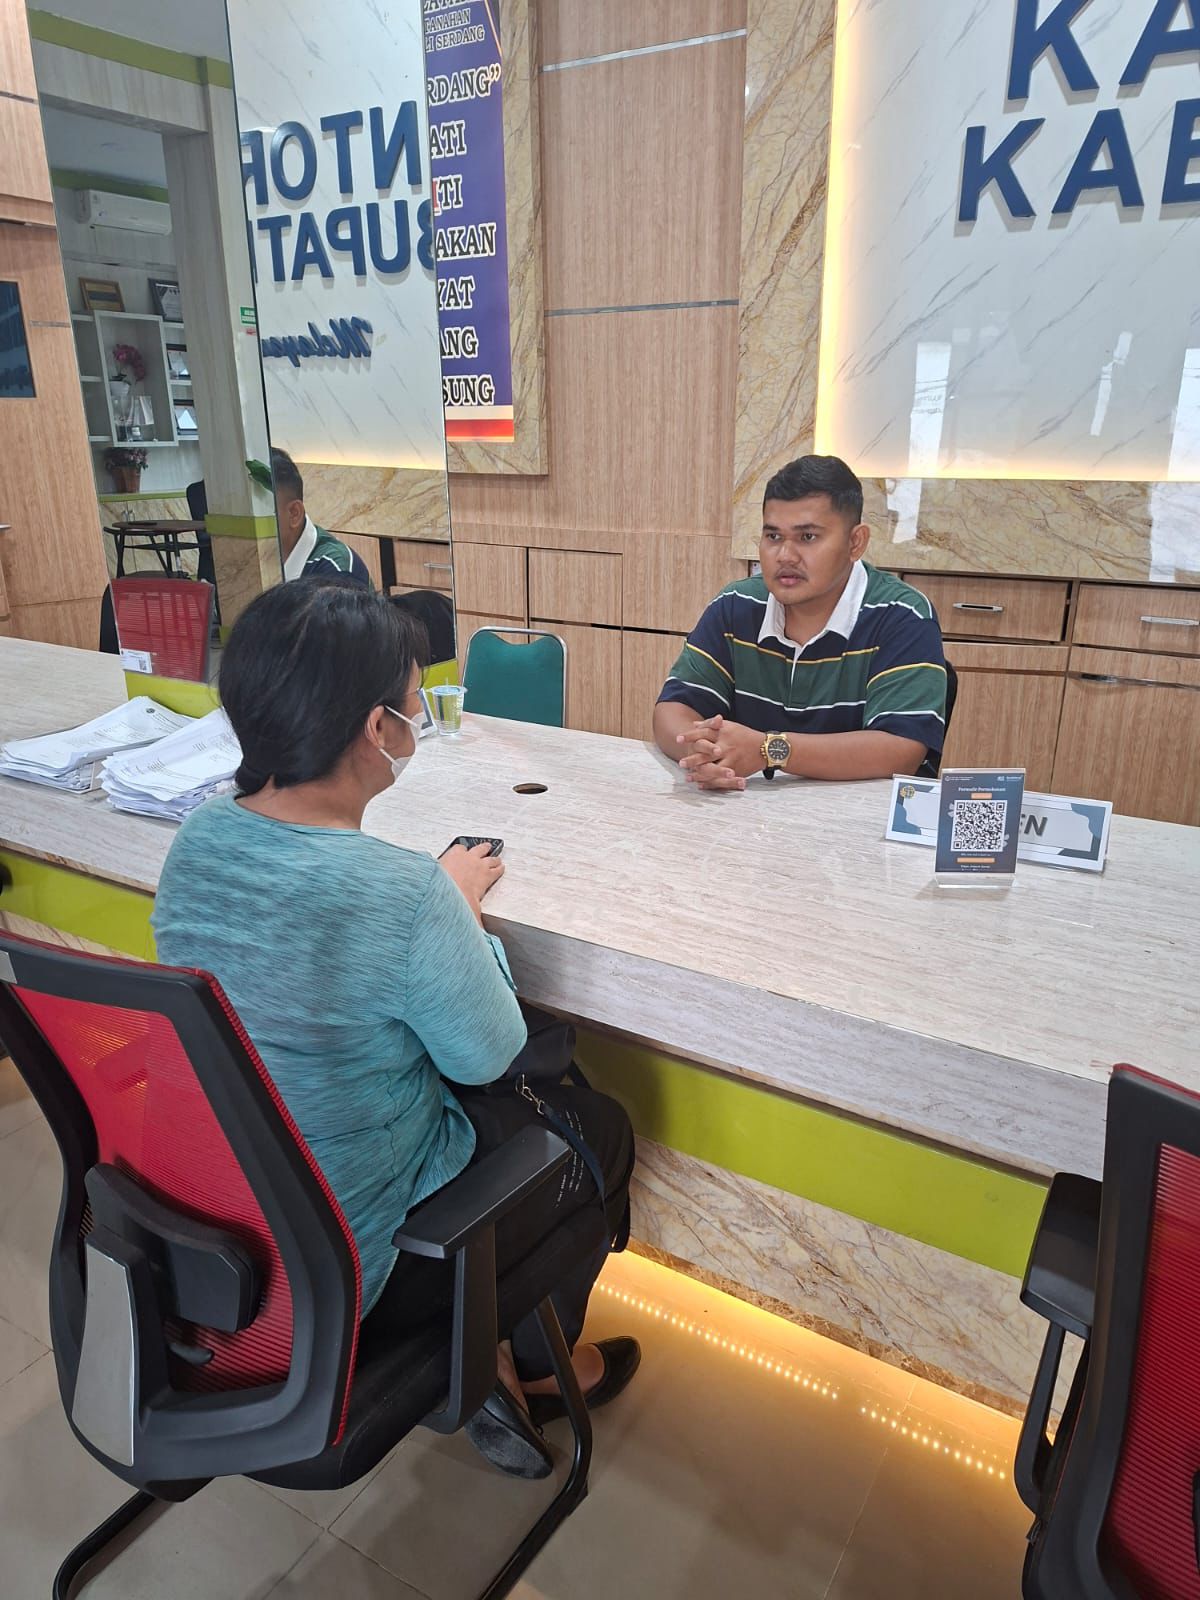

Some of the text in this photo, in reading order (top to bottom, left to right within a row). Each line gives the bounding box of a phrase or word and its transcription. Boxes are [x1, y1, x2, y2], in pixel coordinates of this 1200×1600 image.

[436, 25, 485, 50] SERDANG
[430, 120, 466, 158] ATI
[435, 223, 496, 260] AKAN
